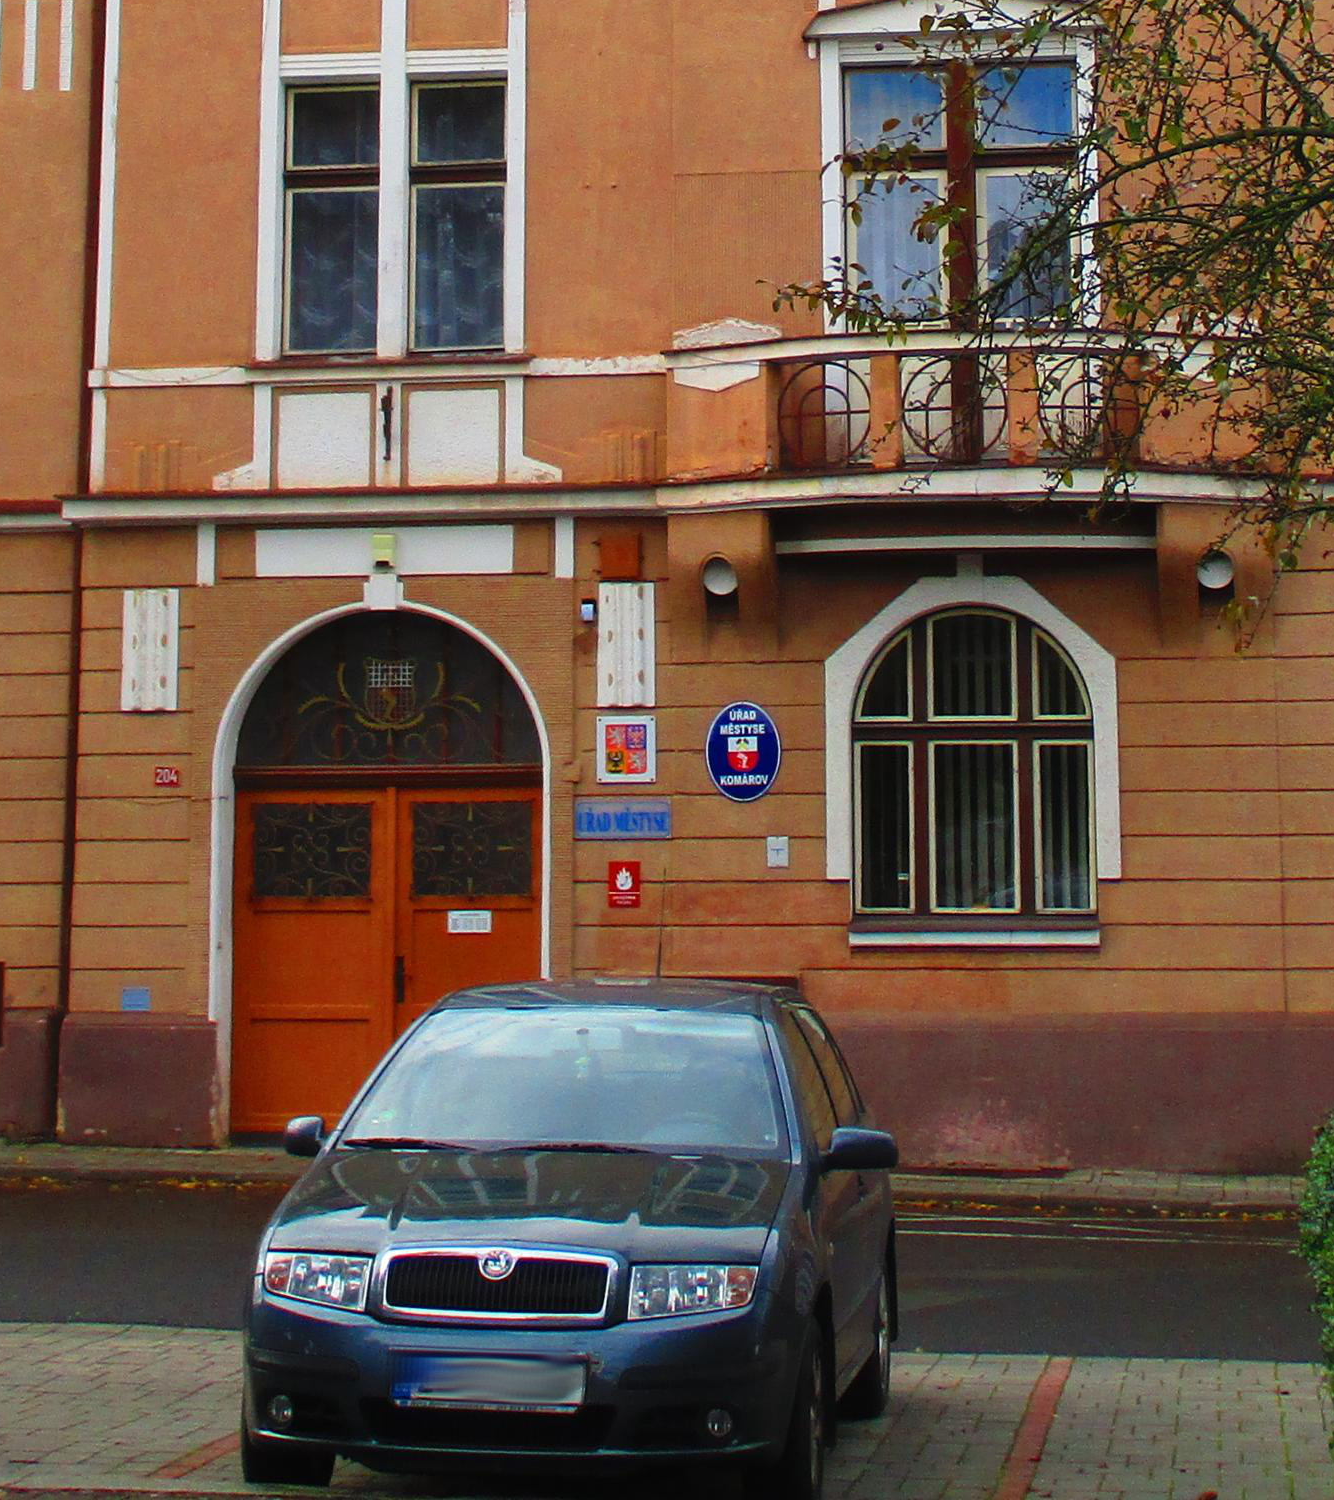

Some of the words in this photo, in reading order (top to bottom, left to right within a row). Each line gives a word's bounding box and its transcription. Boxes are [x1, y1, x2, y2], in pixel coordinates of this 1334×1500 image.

[729, 708, 757, 721] ÚŘAD
[719, 722, 766, 735] MĚSTYSE
[156, 769, 178, 783] 204
[719, 772, 769, 786] KOMÁROV
